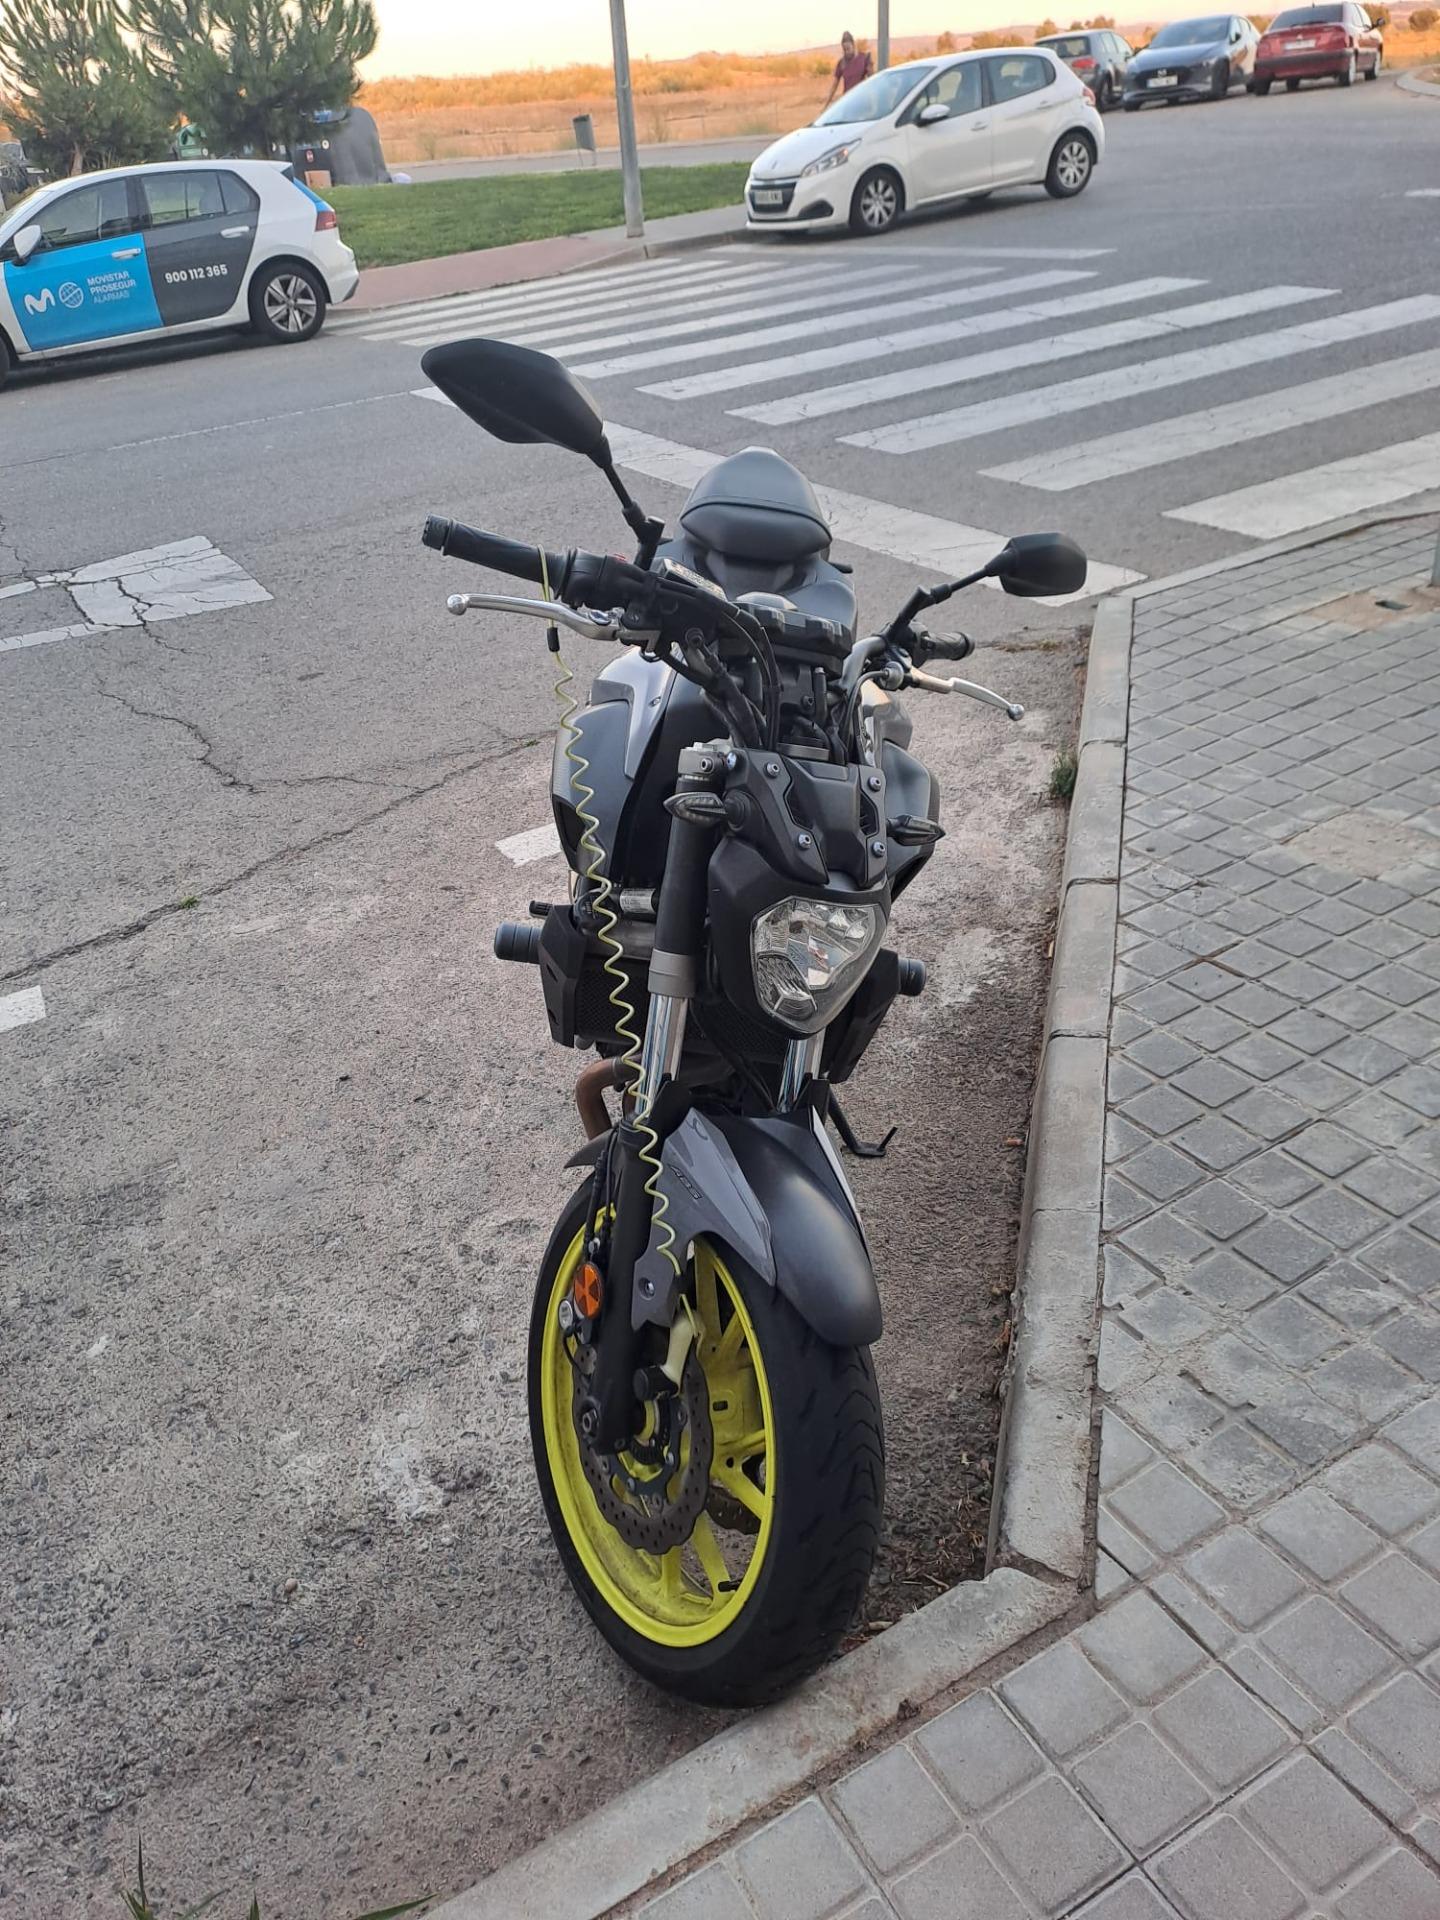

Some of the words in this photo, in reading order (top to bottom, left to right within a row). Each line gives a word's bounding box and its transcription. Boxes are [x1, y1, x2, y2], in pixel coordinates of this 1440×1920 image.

[87, 271, 130, 286] MOVISTAR
[165, 271, 188, 284] 900
[190, 268, 205, 281] 112
[207, 264, 228, 277] 365
[90, 279, 136, 295] PROSEGUR
[93, 290, 130, 304] ALARMAS
